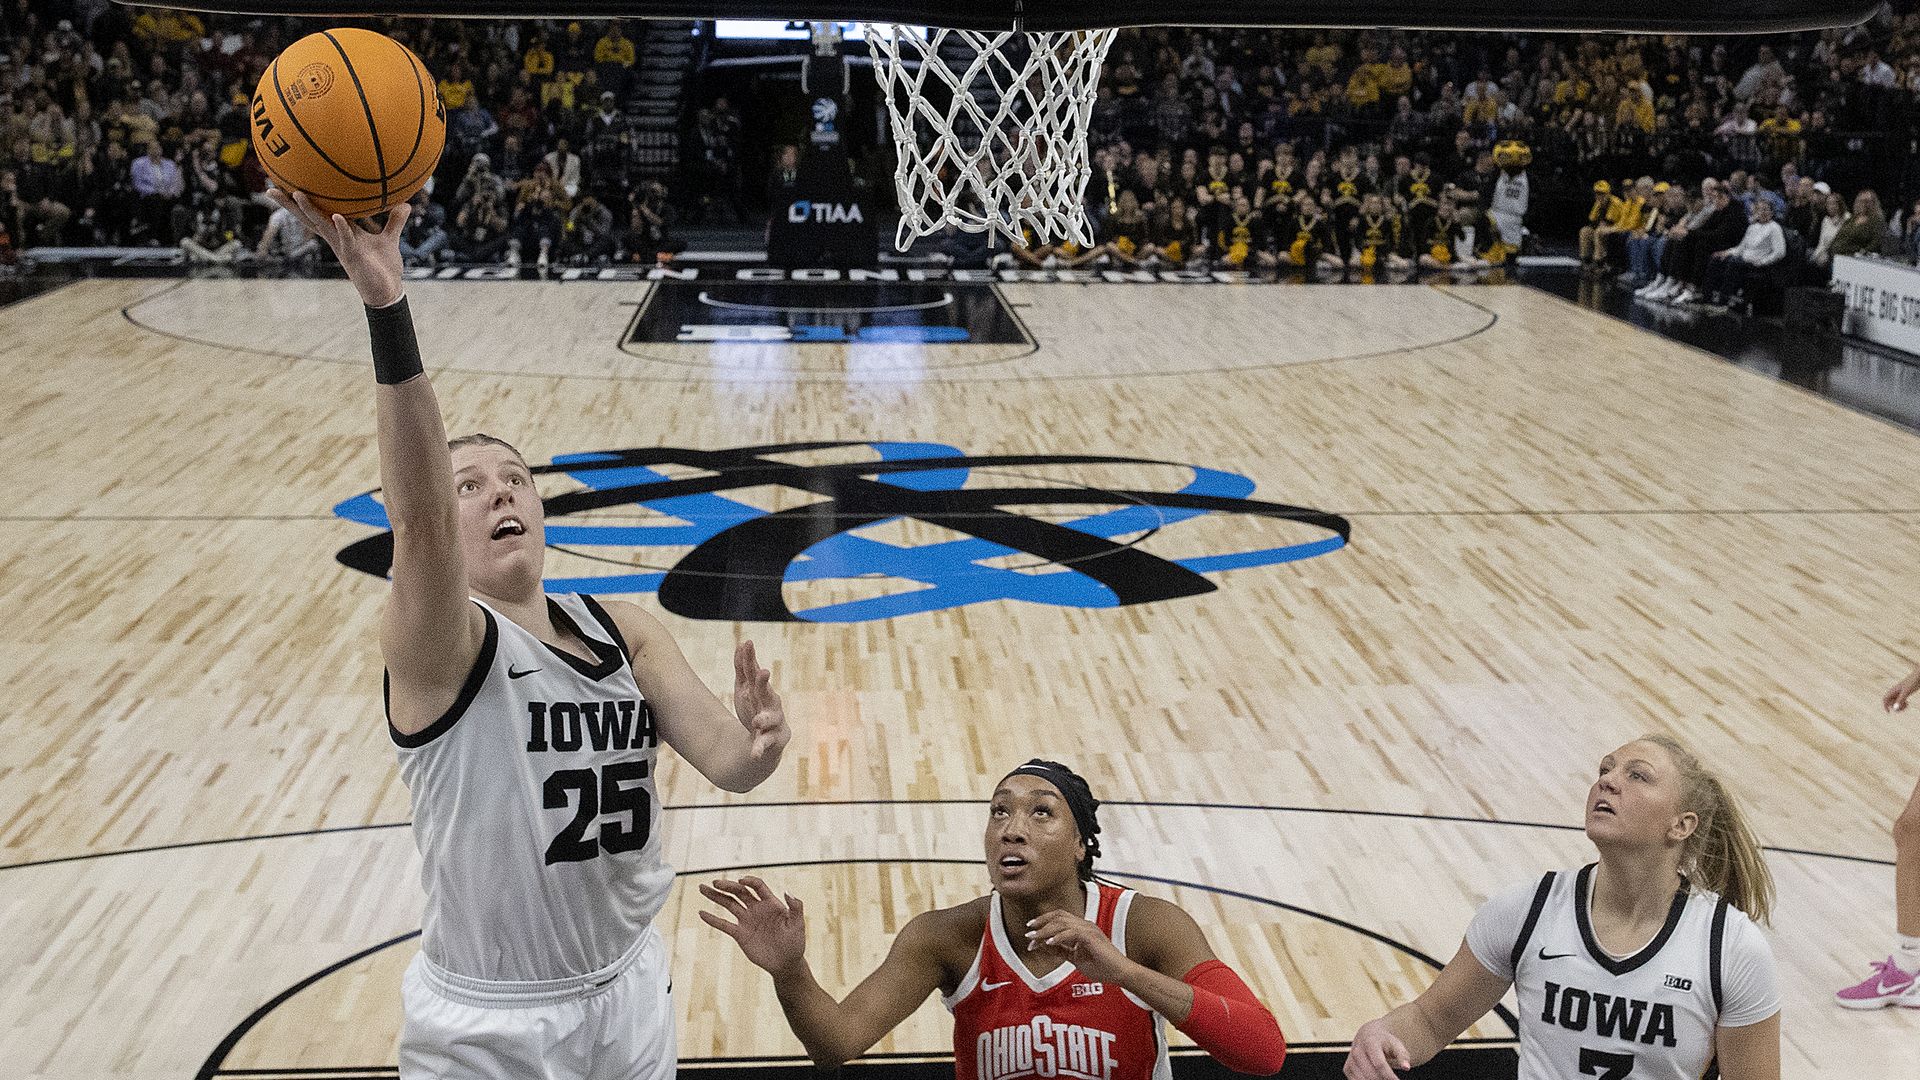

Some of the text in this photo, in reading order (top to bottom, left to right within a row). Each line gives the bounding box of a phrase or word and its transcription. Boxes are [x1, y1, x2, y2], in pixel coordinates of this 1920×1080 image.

[811, 202, 864, 223] TIAA
[1880, 290, 1898, 322] BIG
[526, 700, 658, 752] IOWA
[543, 760, 652, 866] 25
[1541, 980, 1677, 1047] IOWA
